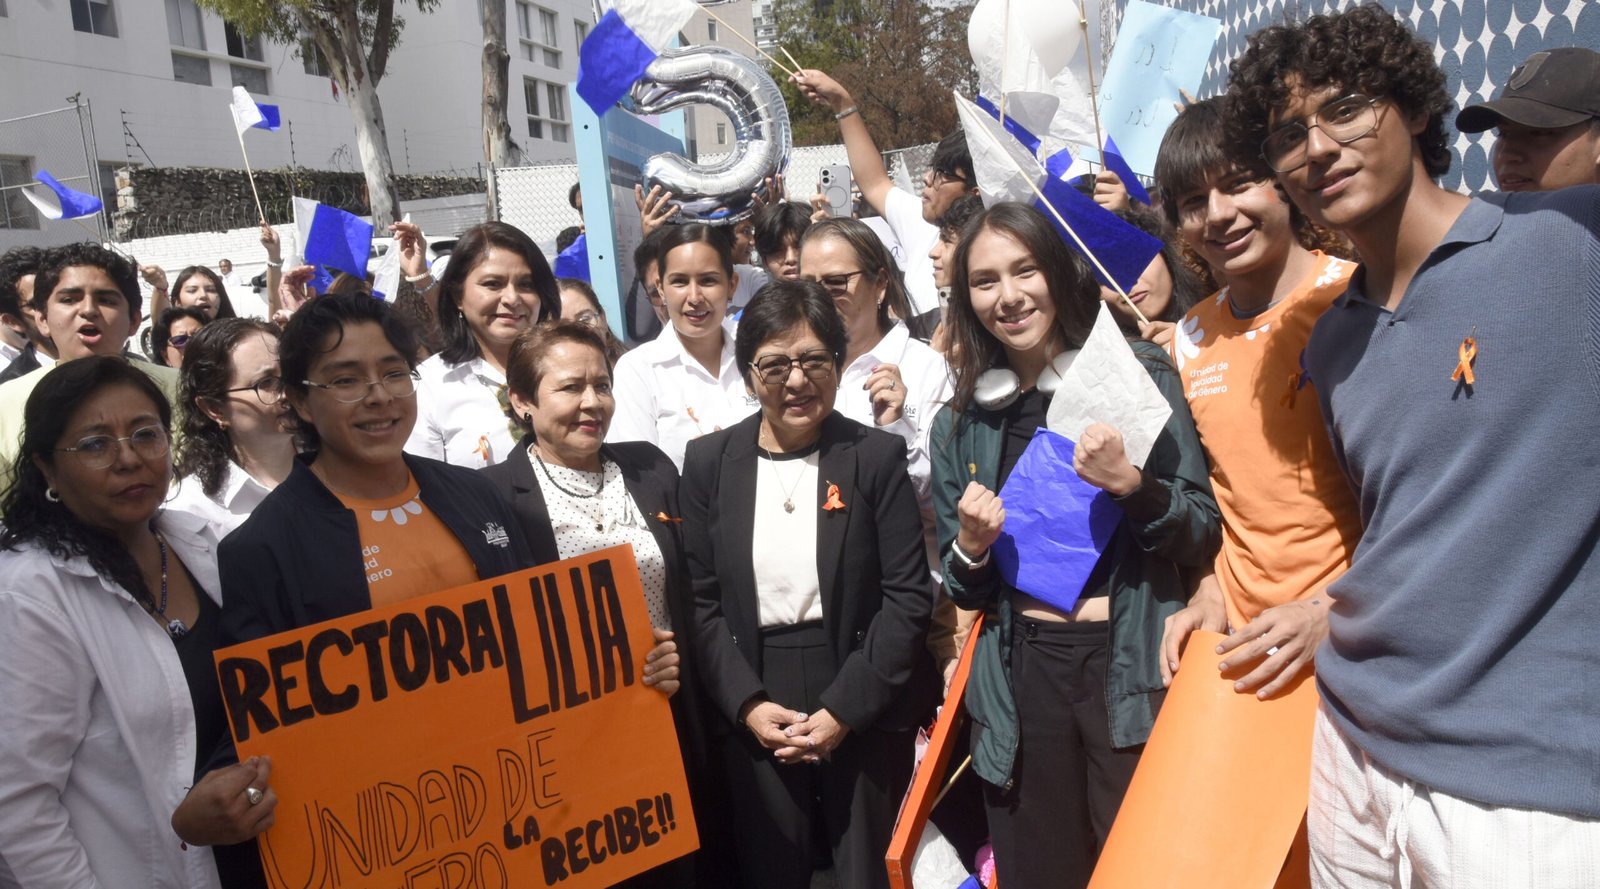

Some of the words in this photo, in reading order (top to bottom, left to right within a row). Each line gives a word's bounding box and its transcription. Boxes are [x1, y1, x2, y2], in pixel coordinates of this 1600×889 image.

[1218, 361, 1229, 371] de
[1188, 391, 1198, 399] de
[362, 545, 380, 556] de
[218, 599, 503, 742] RECTORA
[493, 559, 634, 724] LILIA
[259, 765, 486, 889] UNIDAD
[497, 728, 563, 823] DE
[504, 815, 540, 850] LA
[540, 792, 676, 886] RECIBE!!
